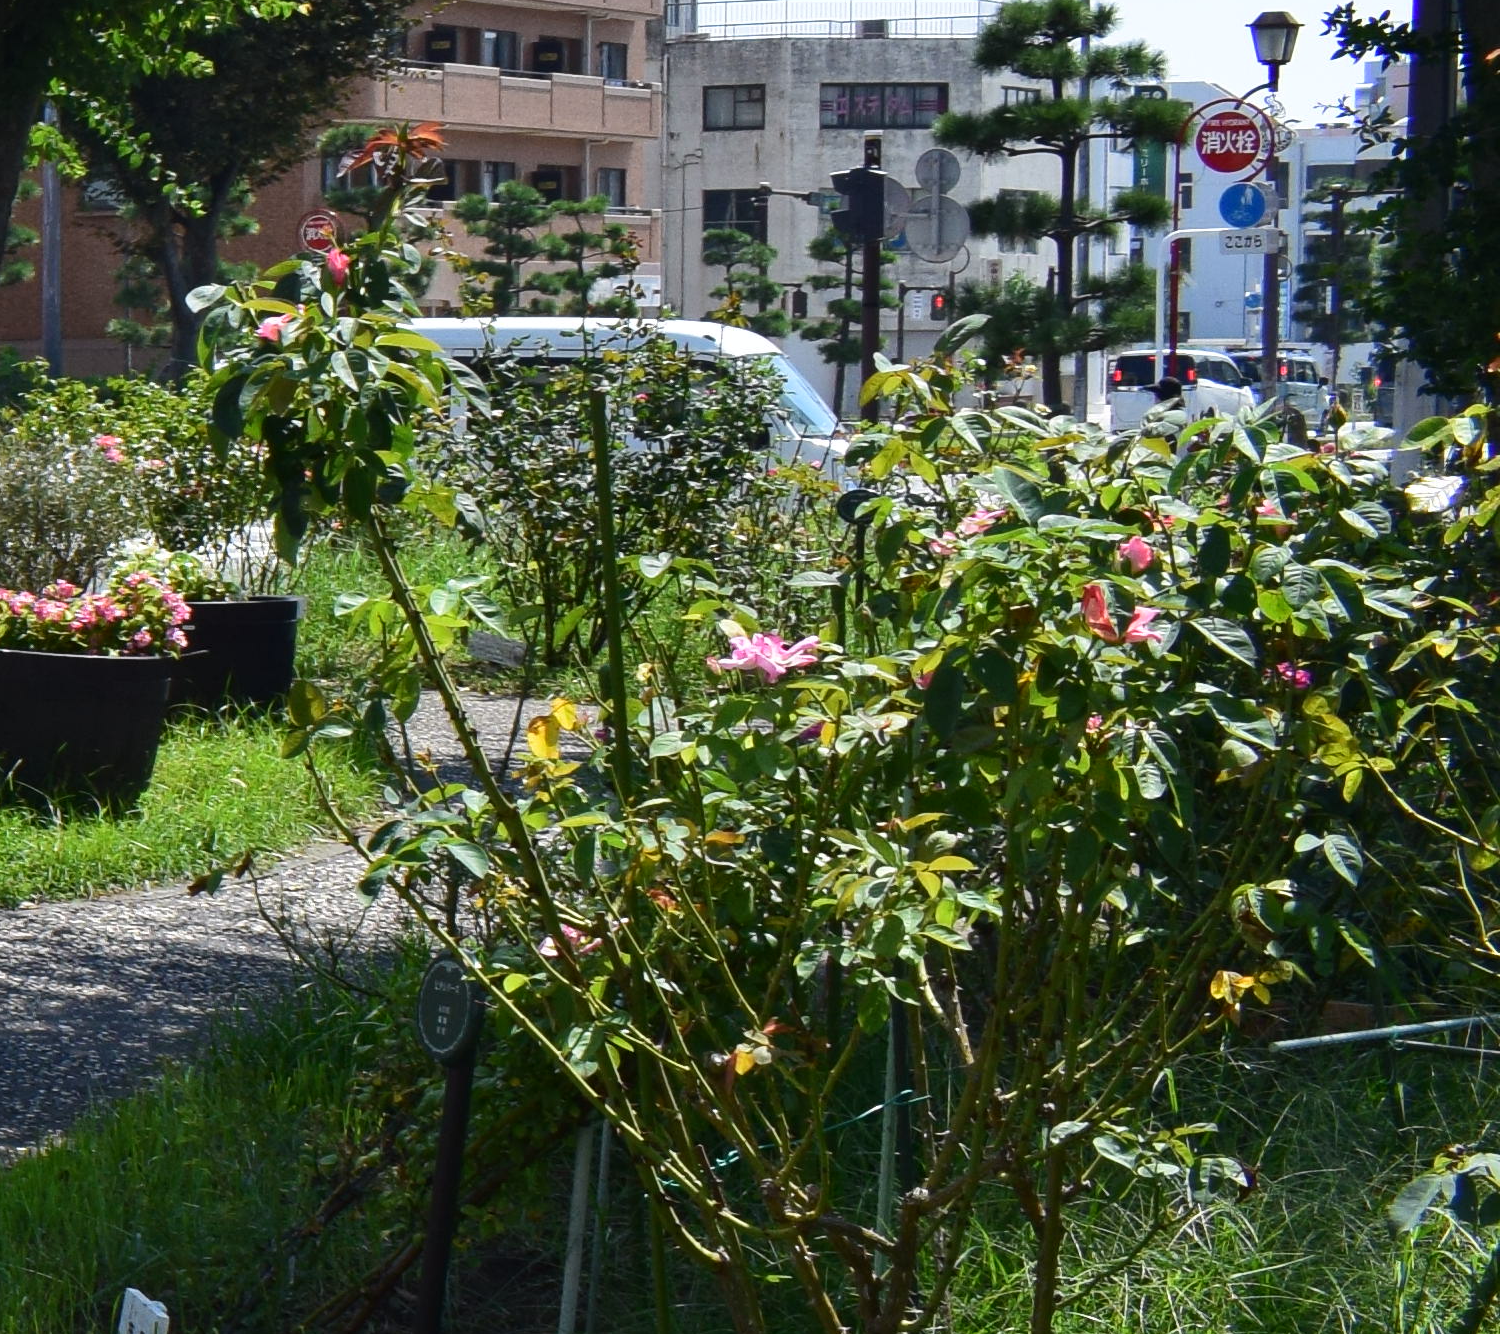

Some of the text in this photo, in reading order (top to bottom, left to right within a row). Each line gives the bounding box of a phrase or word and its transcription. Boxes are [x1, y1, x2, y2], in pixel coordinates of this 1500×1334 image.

[1202, 130, 1257, 155] 消火栓
[1225, 234, 1263, 248] ここから
